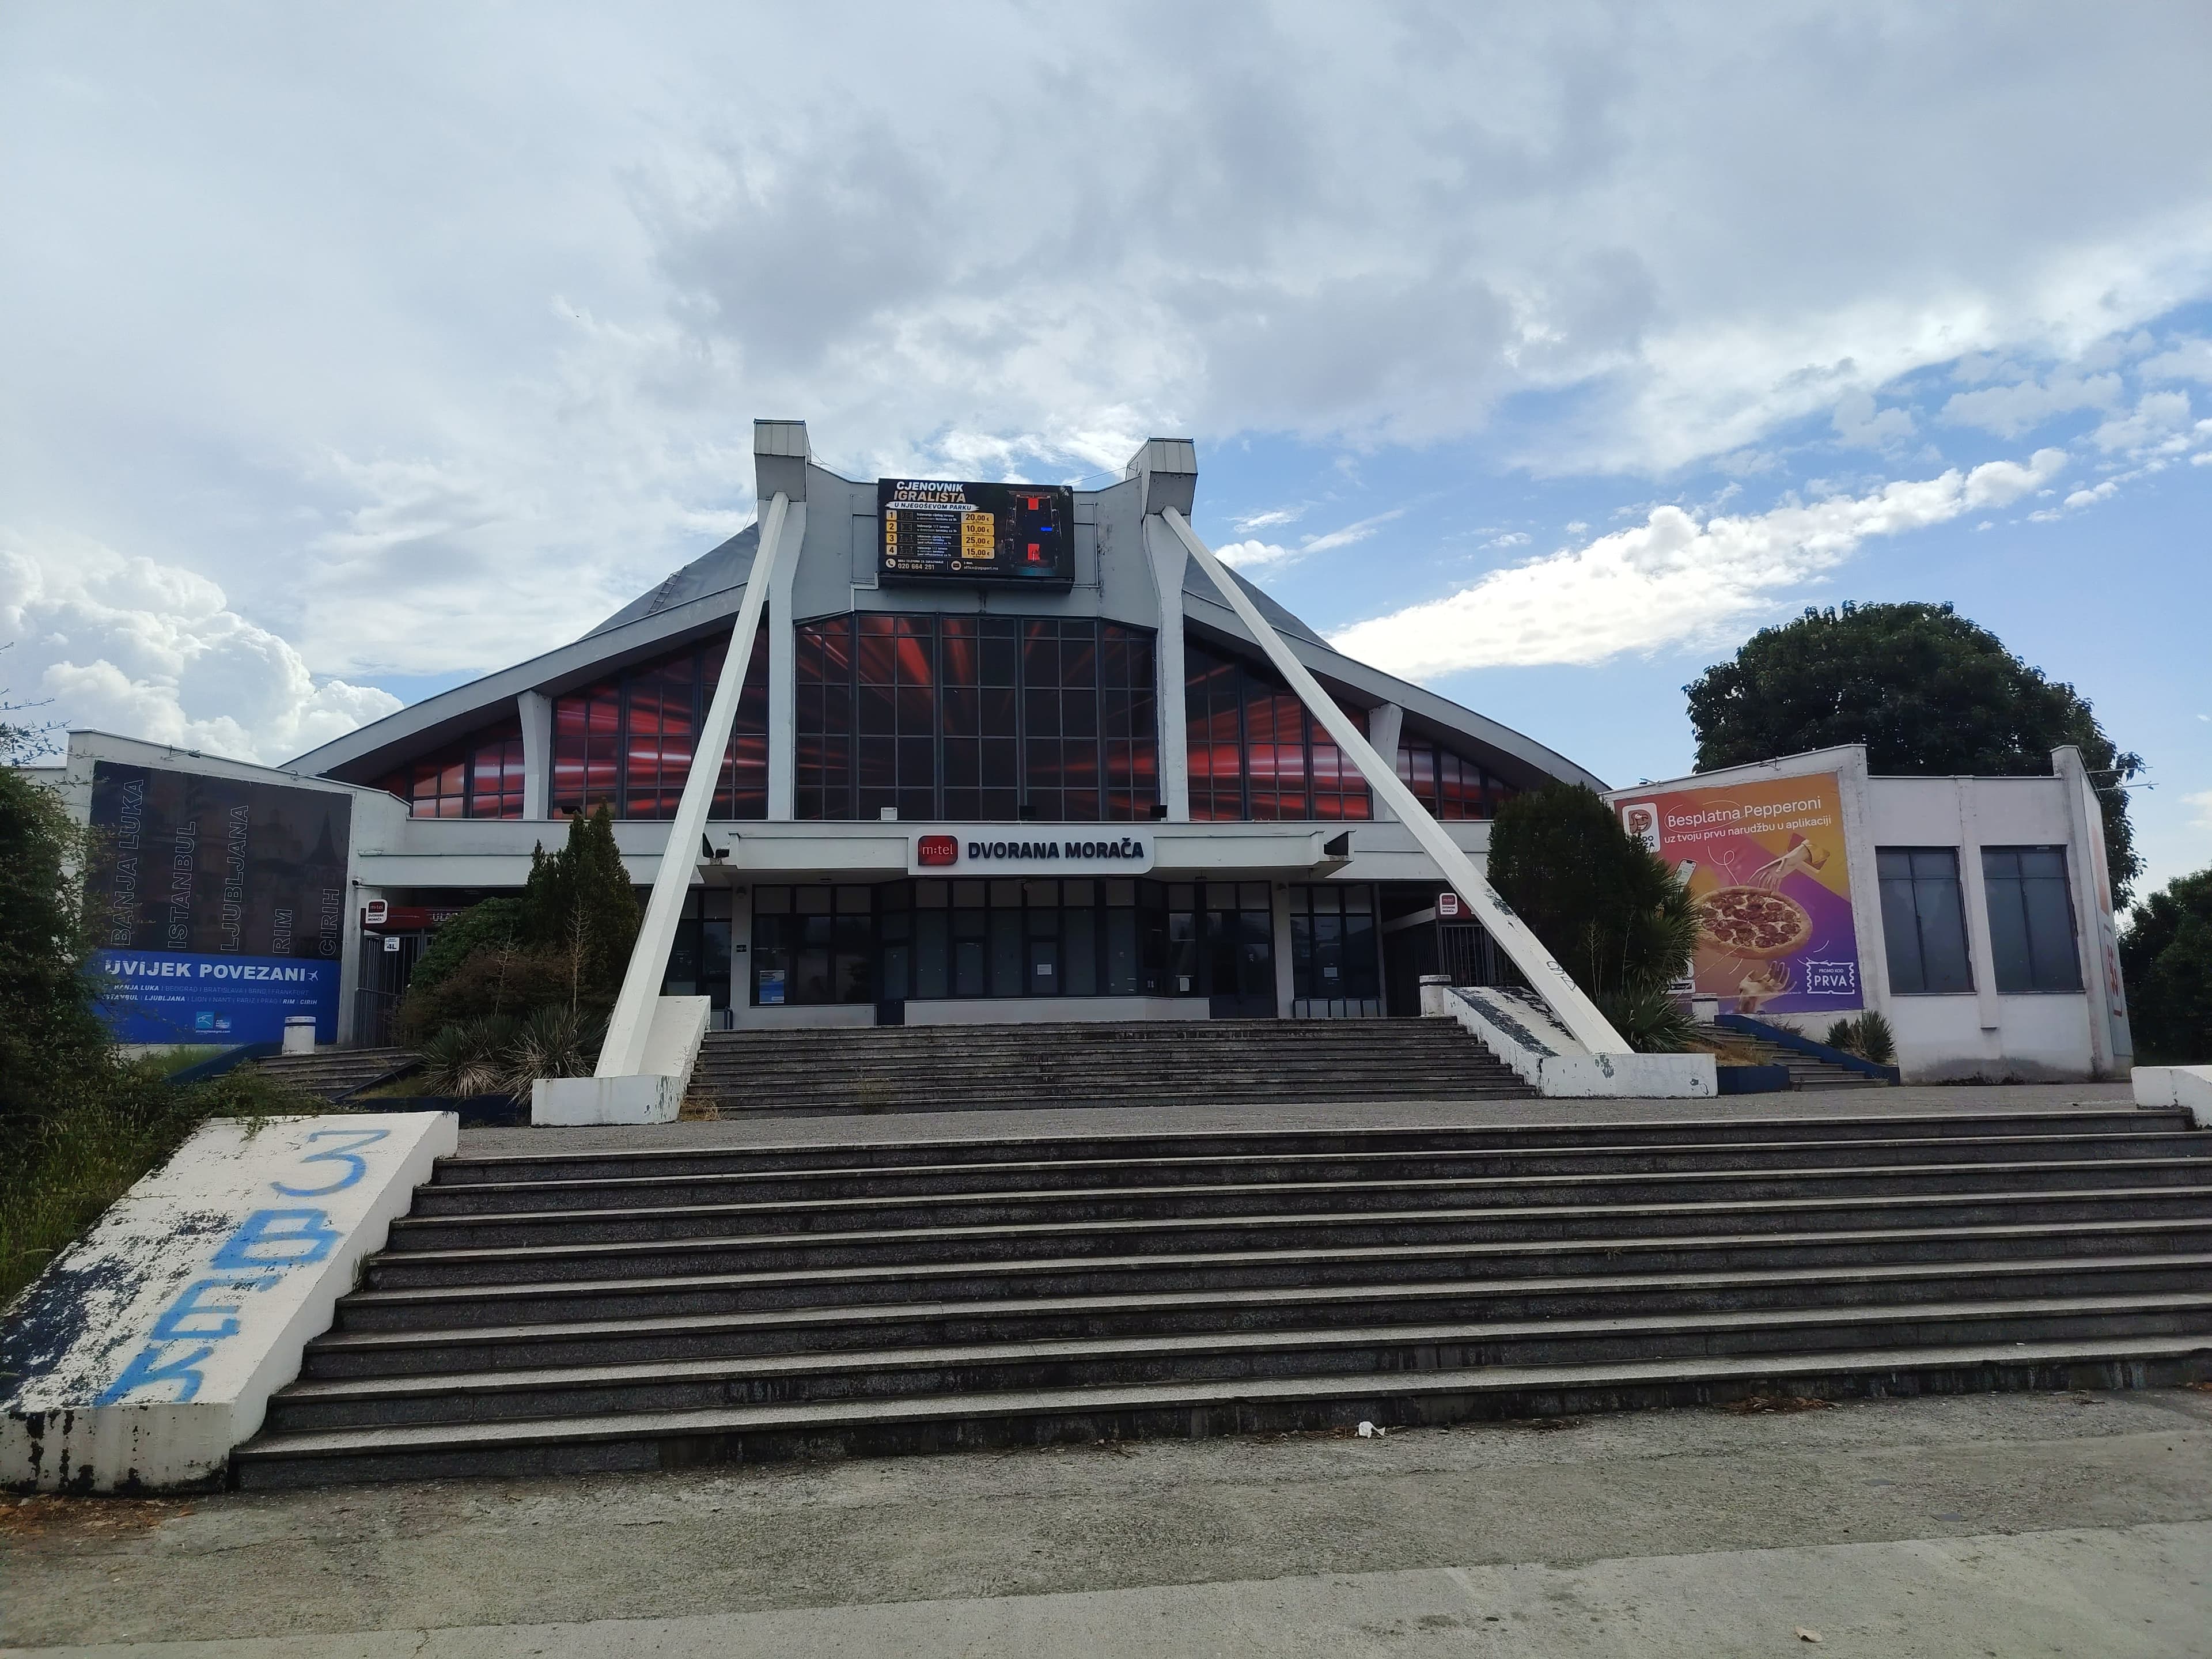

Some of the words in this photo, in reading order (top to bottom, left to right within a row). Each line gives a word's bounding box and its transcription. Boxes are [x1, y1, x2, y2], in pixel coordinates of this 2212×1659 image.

[896, 481, 964, 492] CJENOVNIK
[120, 779, 144, 849] LUKA
[1664, 836, 1676, 844] uz
[1677, 833, 1702, 843] tvoju
[1704, 830, 1726, 840] prvu
[1728, 821, 1775, 836] narudžbu
[1786, 815, 1832, 831] aplikaciji
[1667, 808, 1741, 828] Besplatna
[1744, 796, 1821, 818] Pepperoni
[922, 843, 953, 857] m:tel
[968, 842, 1060, 859] DVORANA
[1065, 837, 1145, 859] MORAČA
[168, 821, 196, 949] ISTANBUL
[221, 805, 249, 952] LJUBLJANA
[111, 858, 138, 946] BANJA
[272, 908, 293, 954] RIM
[319, 889, 340, 956] CIRIH
[105, 960, 192, 978] UVIJEK
[199, 963, 306, 981] POVEZANI
[1814, 975, 1847, 986] PRVA
